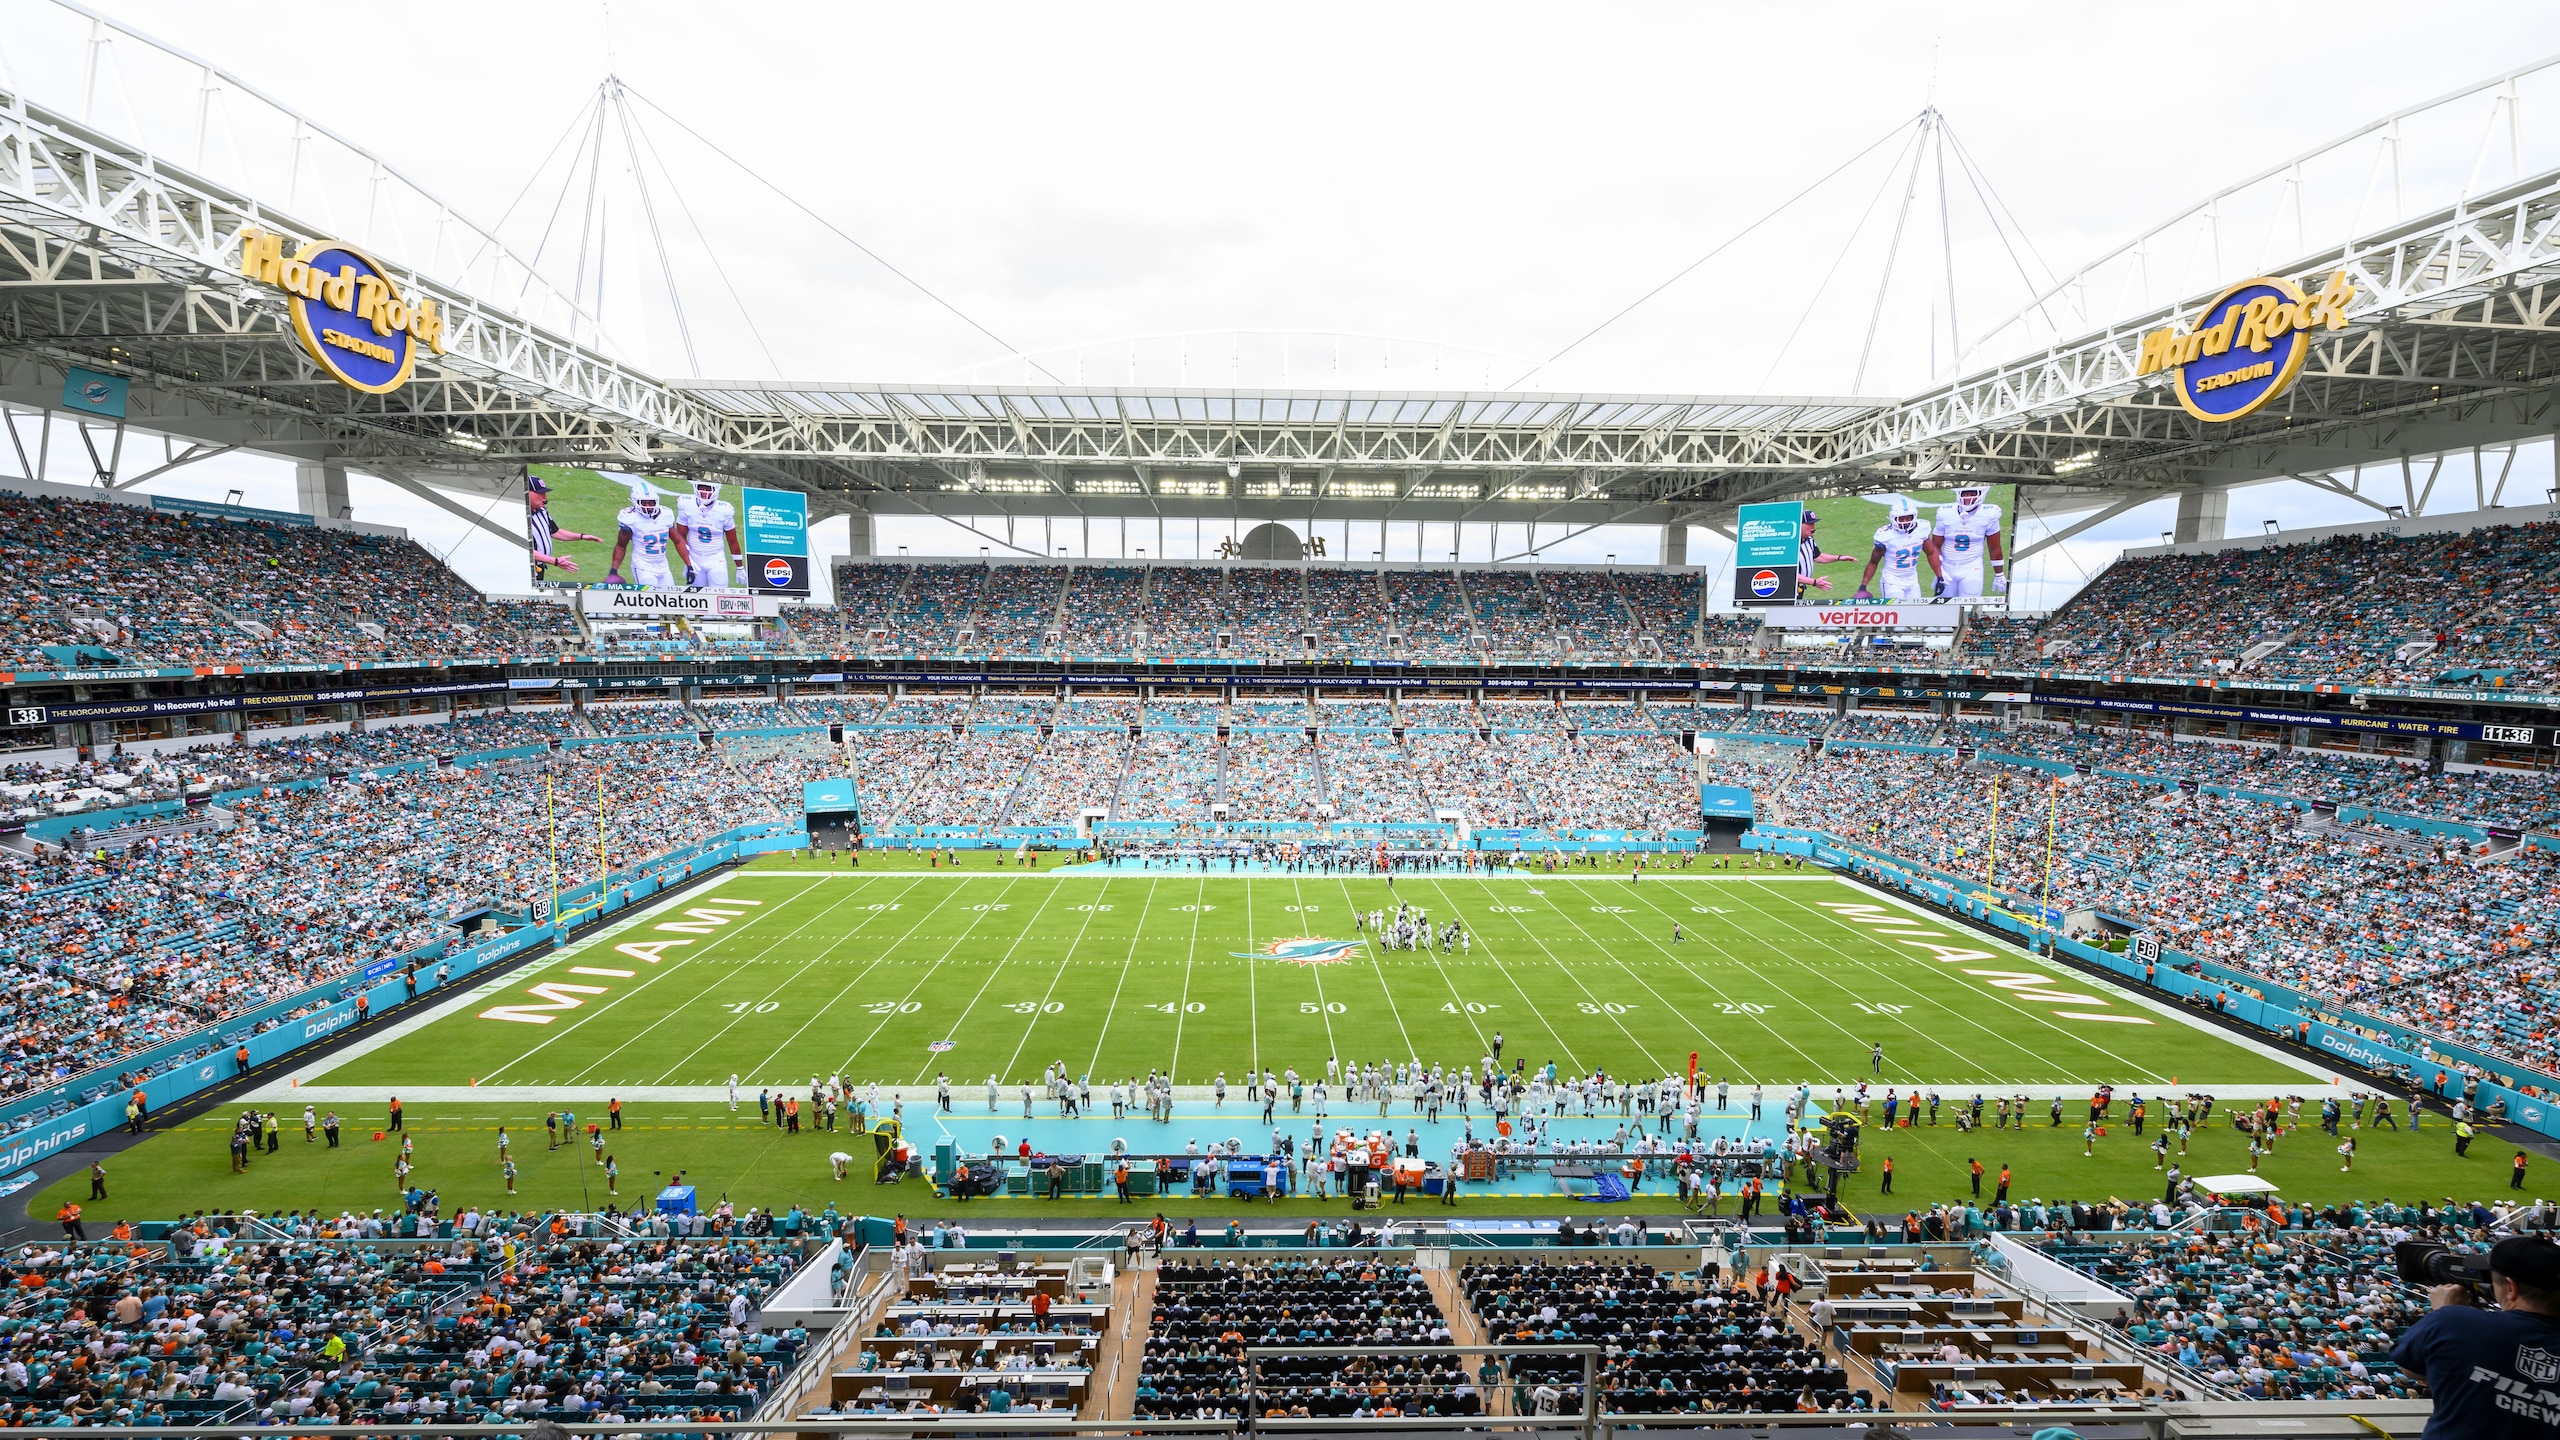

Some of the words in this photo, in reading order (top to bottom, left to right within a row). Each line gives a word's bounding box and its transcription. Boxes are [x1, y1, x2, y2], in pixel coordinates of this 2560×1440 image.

[240, 228, 356, 312] Hard
[356, 274, 446, 355] Rock
[2136, 304, 2242, 376] Hard
[2234, 271, 2355, 353] Rock
[322, 328, 395, 364] STADIUM
[2196, 361, 2274, 393] STADIUM
[95, 492, 112, 502] 306
[2385, 525, 2401, 535] 330
[613, 593, 708, 609] AutoNation
[720, 600, 733, 610] DRV
[737, 600, 750, 611] PNK
[1818, 608, 1898, 625] verizon
[62, 671, 99, 681] JASON
[103, 670, 142, 680] TAYLOR
[143, 669, 159, 678] 99
[264, 665, 286, 673] ZACH
[2230, 681, 2251, 689] MARK
[2252, 682, 2286, 691] CLAYTON
[2288, 683, 2300, 691] 83
[2409, 690, 2430, 698] DAN
[2432, 691, 2472, 700] MARINO
[2475, 693, 2488, 701] 13
[2505, 695, 2529, 703] 8,358
[51, 710, 68, 718] THE
[69, 708, 105, 717] MORGAN
[121, 705, 149, 713] GROUP
[154, 703, 166, 711] No
[167, 700, 207, 711] Recovery,
[207, 700, 219, 708] No
[219, 699, 236, 707] Fee!
[242, 697, 261, 705] FREE
[261, 693, 314, 704] CONSULTATION
[317, 691, 363, 700] 305-569-9900
[18, 709, 39, 723] 38
[2340, 718, 2389, 729] HURRICANE
[2398, 722, 2429, 732] WATER
[2438, 726, 2459, 734] FIRE
[2486, 726, 2530, 742] 11:36
[536, 901, 548, 915] 38
[477, 939, 520, 964] Dolphins
[2138, 941, 2156, 957] 38
[477, 898, 763, 1025] MIAMI
[1815, 901, 2157, 1025] MIAMI
[726, 1001, 780, 1014] 10
[867, 1001, 922, 1014] 20
[1014, 1001, 1065, 1014] 30
[1156, 1001, 1207, 1014] 40
[1299, 1002, 1347, 1014] 50
[1440, 1002, 1488, 1014] 40
[1576, 1002, 1627, 1014] 30
[1712, 1002, 1766, 1014] 20
[1851, 1002, 1901, 1014] 10
[304, 1007, 360, 1038] Dolphin
[2325, 1029, 2360, 1046] MIAMI
[2321, 1034, 2389, 1066] Dolphin
[0, 1122, 86, 1168] olphins
[1371, 1156, 1381, 1166] G
[1320, 1231, 1328, 1239] 25
[2520, 1358, 2554, 1379] NFL
[1540, 1396, 1554, 1413] 13
[2495, 1393, 2560, 1427] CREW
